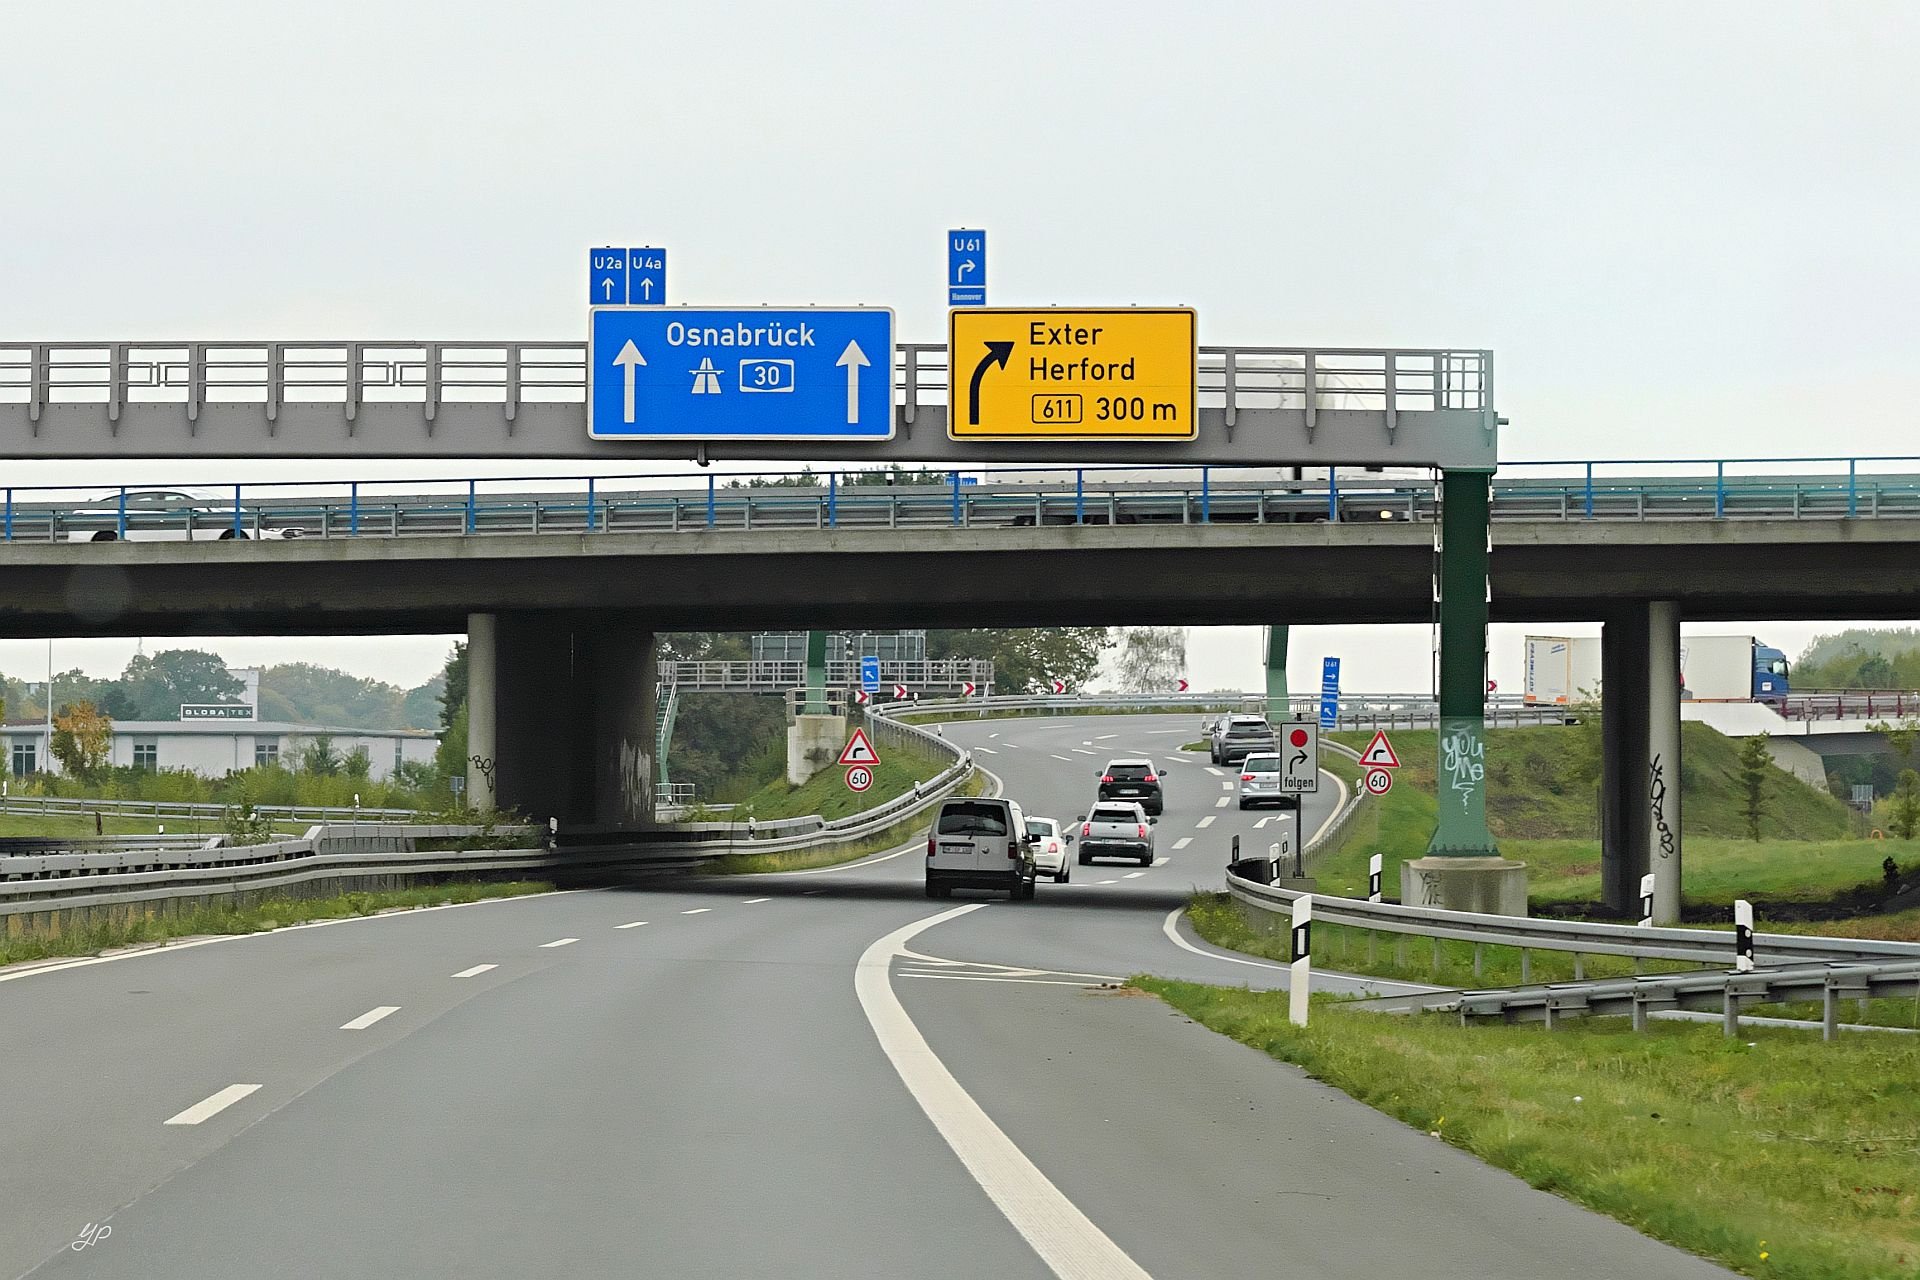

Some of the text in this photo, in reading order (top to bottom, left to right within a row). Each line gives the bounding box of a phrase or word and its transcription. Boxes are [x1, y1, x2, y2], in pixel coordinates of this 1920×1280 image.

[666, 321, 816, 347] Osnabrück
[1030, 321, 1103, 346] Exter
[754, 365, 780, 386] 30
[1030, 357, 1135, 381] Herford
[1042, 397, 1177, 421] 611 300 m
[852, 772, 867, 785] 60
[1284, 776, 1314, 790] folgen
[1371, 775, 1387, 788] 60
